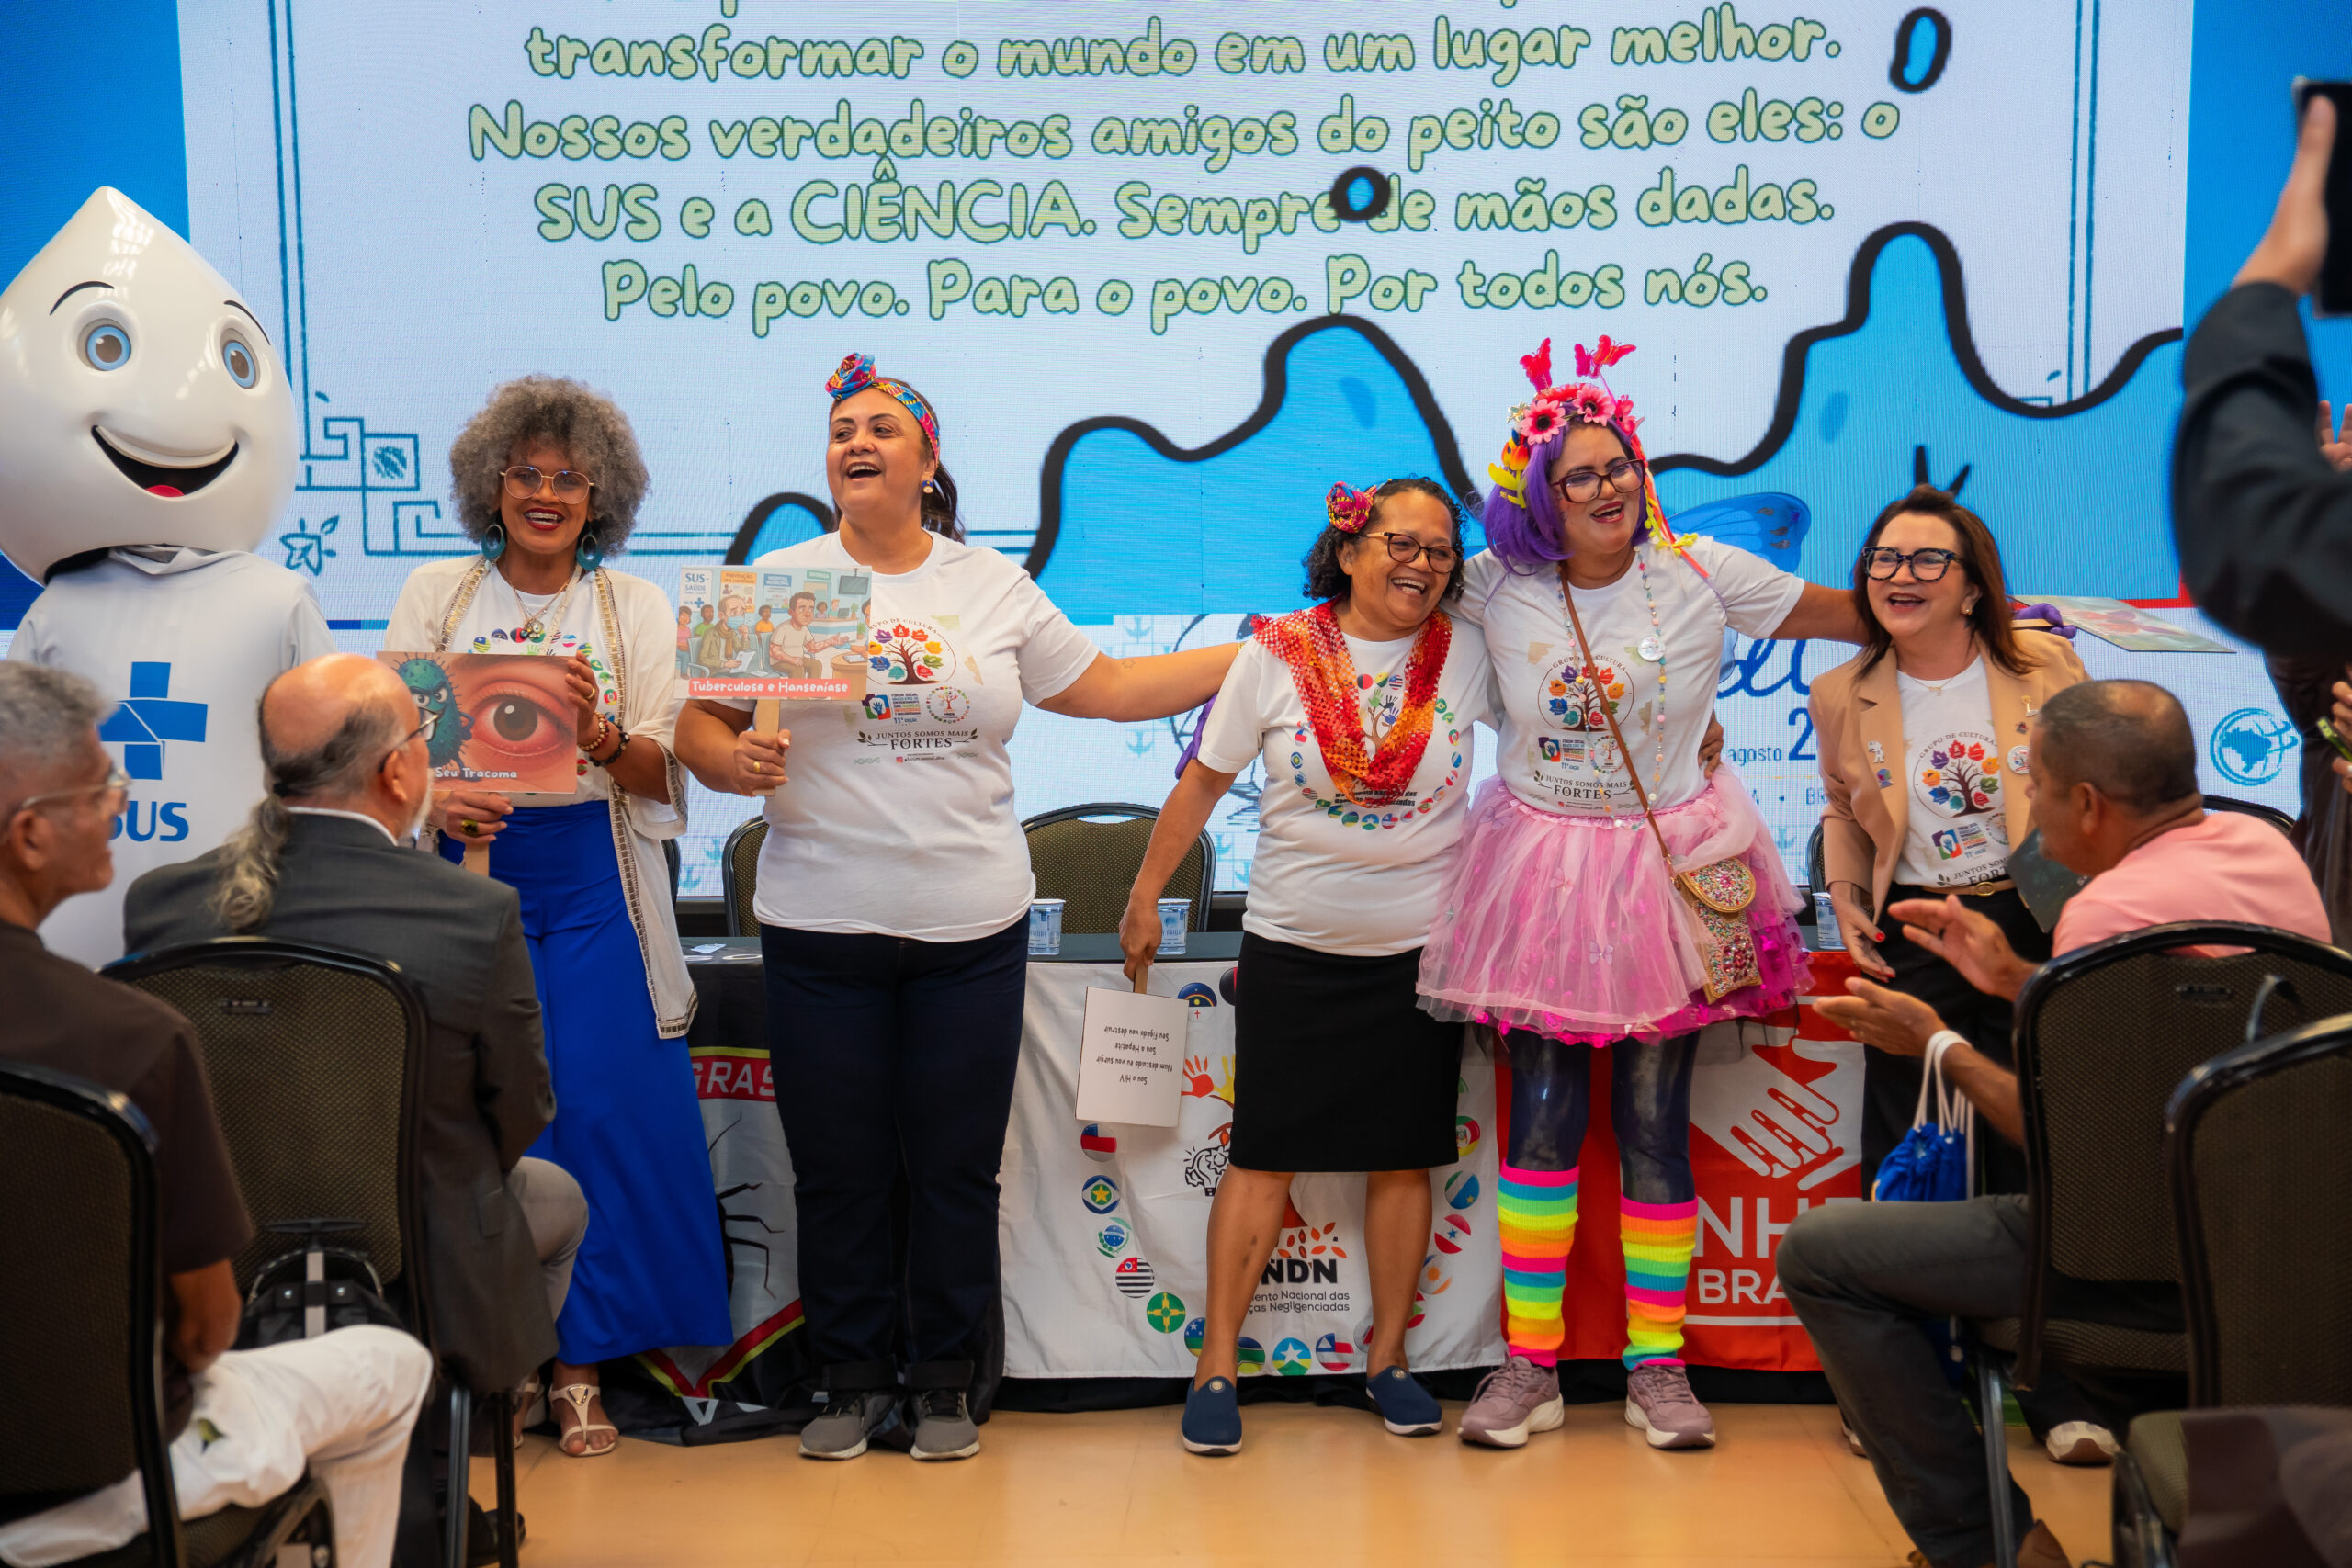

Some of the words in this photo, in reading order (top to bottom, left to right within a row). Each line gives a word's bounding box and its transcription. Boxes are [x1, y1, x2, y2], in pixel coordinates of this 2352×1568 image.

[525, 24, 923, 81] transformar
[942, 40, 979, 77] o
[997, 17, 1197, 77] mundo
[1215, 30, 1306, 73] em
[1324, 25, 1415, 73] um
[1434, 15, 1591, 86] lugar
[1611, 2, 1842, 67] melhor.
[469, 100, 690, 160] Nossos
[709, 98, 1072, 160] verdadeiros
[1091, 105, 1298, 172] amigos
[1317, 94, 1389, 154] do
[1408, 99, 1559, 172] peito
[1578, 94, 1688, 150] são
[1707, 87, 1845, 143] eles:
[1861, 102, 1900, 139] o
[535, 183, 662, 242] SUS
[679, 196, 716, 238] e
[734, 198, 772, 238] a
[790, 156, 1097, 243] CIÊNCIA.
[1114, 181, 1340, 254] Sempre
[1364, 174, 1434, 232] de
[1454, 178, 1617, 233] mãos
[1636, 164, 1835, 225] dadas.
[602, 259, 734, 321] Pelo
[752, 277, 910, 338] povo.
[927, 258, 1079, 320] Para
[1096, 277, 1133, 315] o
[1151, 271, 1307, 335] povo.
[1326, 254, 1438, 314] Por
[1455, 249, 1625, 309] todos
[1644, 253, 1767, 306] nós.
[691, 680, 764, 693] Tuberculose
[778, 682, 848, 693] Hanseníase
[876, 730, 912, 739] JUNTOS
[890, 737, 953, 750] FORTES
[1727, 747, 1782, 766] agosto
[435, 766, 458, 778] Seu
[462, 767, 518, 779] Tracoma
[1545, 775, 1573, 786] JUNTOS
[1554, 785, 1611, 799] FORTES
[1954, 864, 1987, 879] JUNTOS
[1104, 1026, 1127, 1036] destruir
[1159, 1032, 1170, 1042] Seu
[1114, 1042, 1140, 1053] Hepatite
[1147, 1047, 1156, 1055] Sou
[1096, 1055, 1114, 1064] surgir
[1135, 1061, 1158, 1071] descuido
[1160, 1063, 1172, 1072] Num
[1120, 1074, 1131, 1083] HIV
[1137, 1077, 1148, 1085] Sou
[1692, 1196, 1862, 1258] NH
[1281, 1291, 1327, 1301] Nacional
[1329, 1292, 1350, 1301] das
[1270, 1302, 1350, 1313] Negligenciadas
